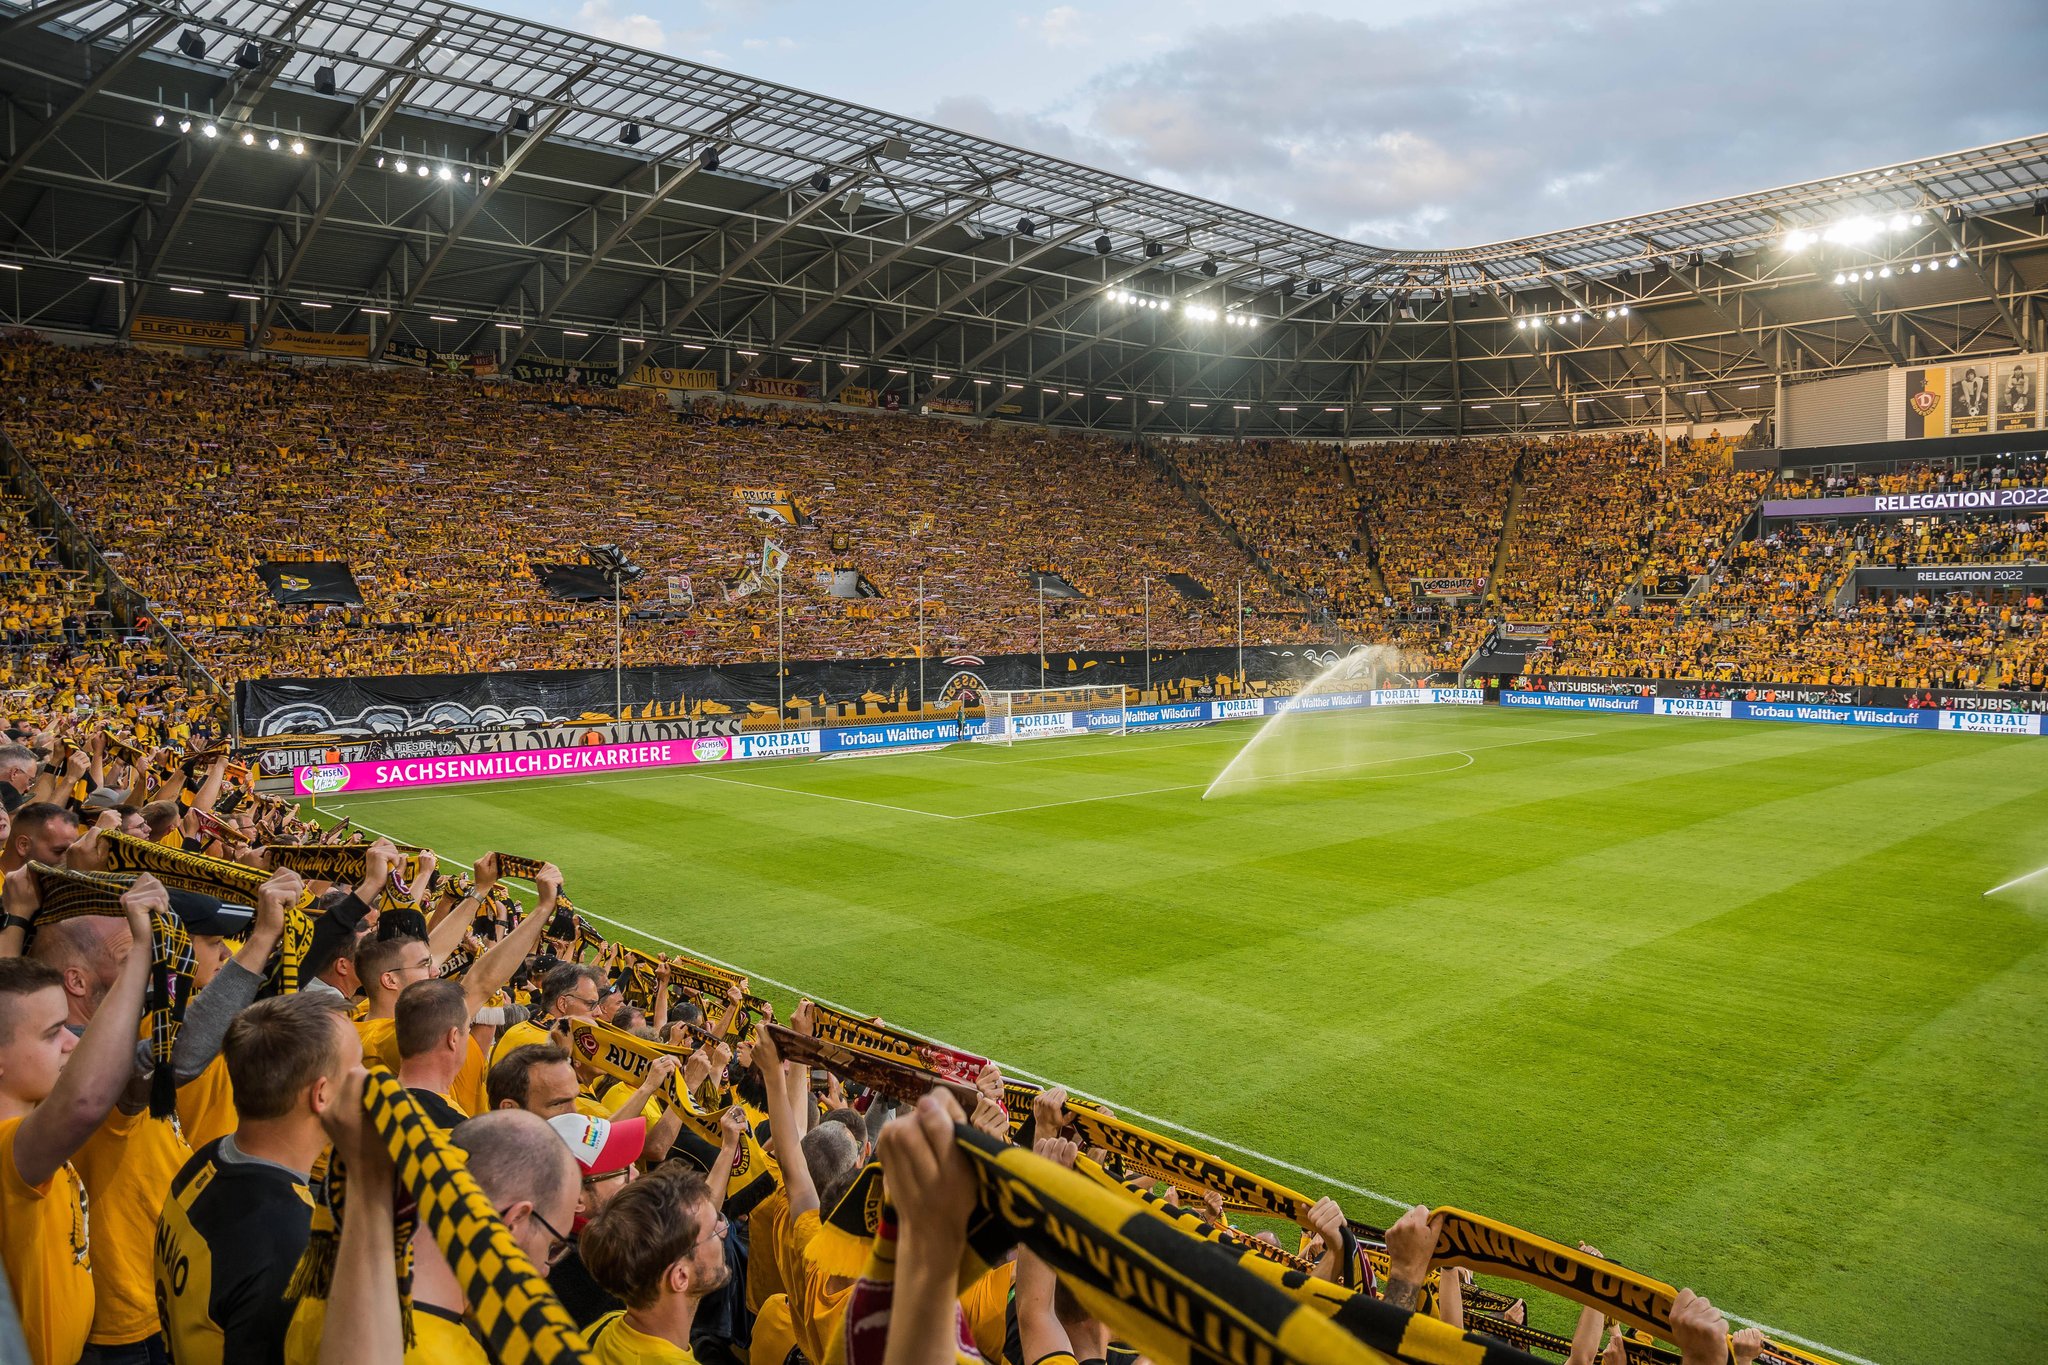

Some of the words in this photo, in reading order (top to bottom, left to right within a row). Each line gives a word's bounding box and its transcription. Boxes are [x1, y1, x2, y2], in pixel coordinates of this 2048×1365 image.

[436, 353, 470, 361] FREITAL
[679, 371, 715, 388] KAIDA
[754, 380, 798, 397] SNAKES
[1917, 394, 1932, 407] D
[1874, 491, 1995, 511] RELEGATION
[2001, 489, 2048, 506] 2022
[1917, 571, 1991, 581] RELEGATION
[1994, 570, 2023, 580] 2022
[1301, 697, 1330, 709] Walther
[1332, 694, 1363, 706] Wilsdruff
[1375, 689, 1419, 705] TORBAU
[1505, 693, 1541, 705] Torbau
[1543, 695, 1586, 708] Walther
[1587, 697, 1639, 710] Wilsdruff
[1217, 699, 1259, 718] TORBAU
[1227, 709, 1259, 717] WALTHER
[1662, 699, 1723, 714] TORBAU
[1749, 705, 1794, 718] Torbau
[1796, 707, 1850, 720] Walther
[1853, 710, 1919, 725] Wilsdruff
[1012, 714, 1065, 734] TORBAU
[1086, 713, 1120, 726] Torbau
[1123, 710, 1159, 723] Walther
[1161, 706, 1201, 720] Wilsdruff
[1950, 711, 2029, 729] TORBAU
[611, 717, 742, 743] MADNESS
[838, 731, 883, 746] Torbau
[886, 727, 934, 743] Walther
[937, 721, 990, 737] Wilsdruff
[1967, 725, 2027, 733] WALTHER
[394, 741, 437, 752] DRESDEN
[697, 741, 724, 749] SACHSEN
[739, 732, 810, 757] TORBAU
[757, 746, 810, 756] WALTHER
[376, 745, 671, 784] SACHSENMILCH.DE/KARRIERE
[284, 852, 334, 871] Dynamo
